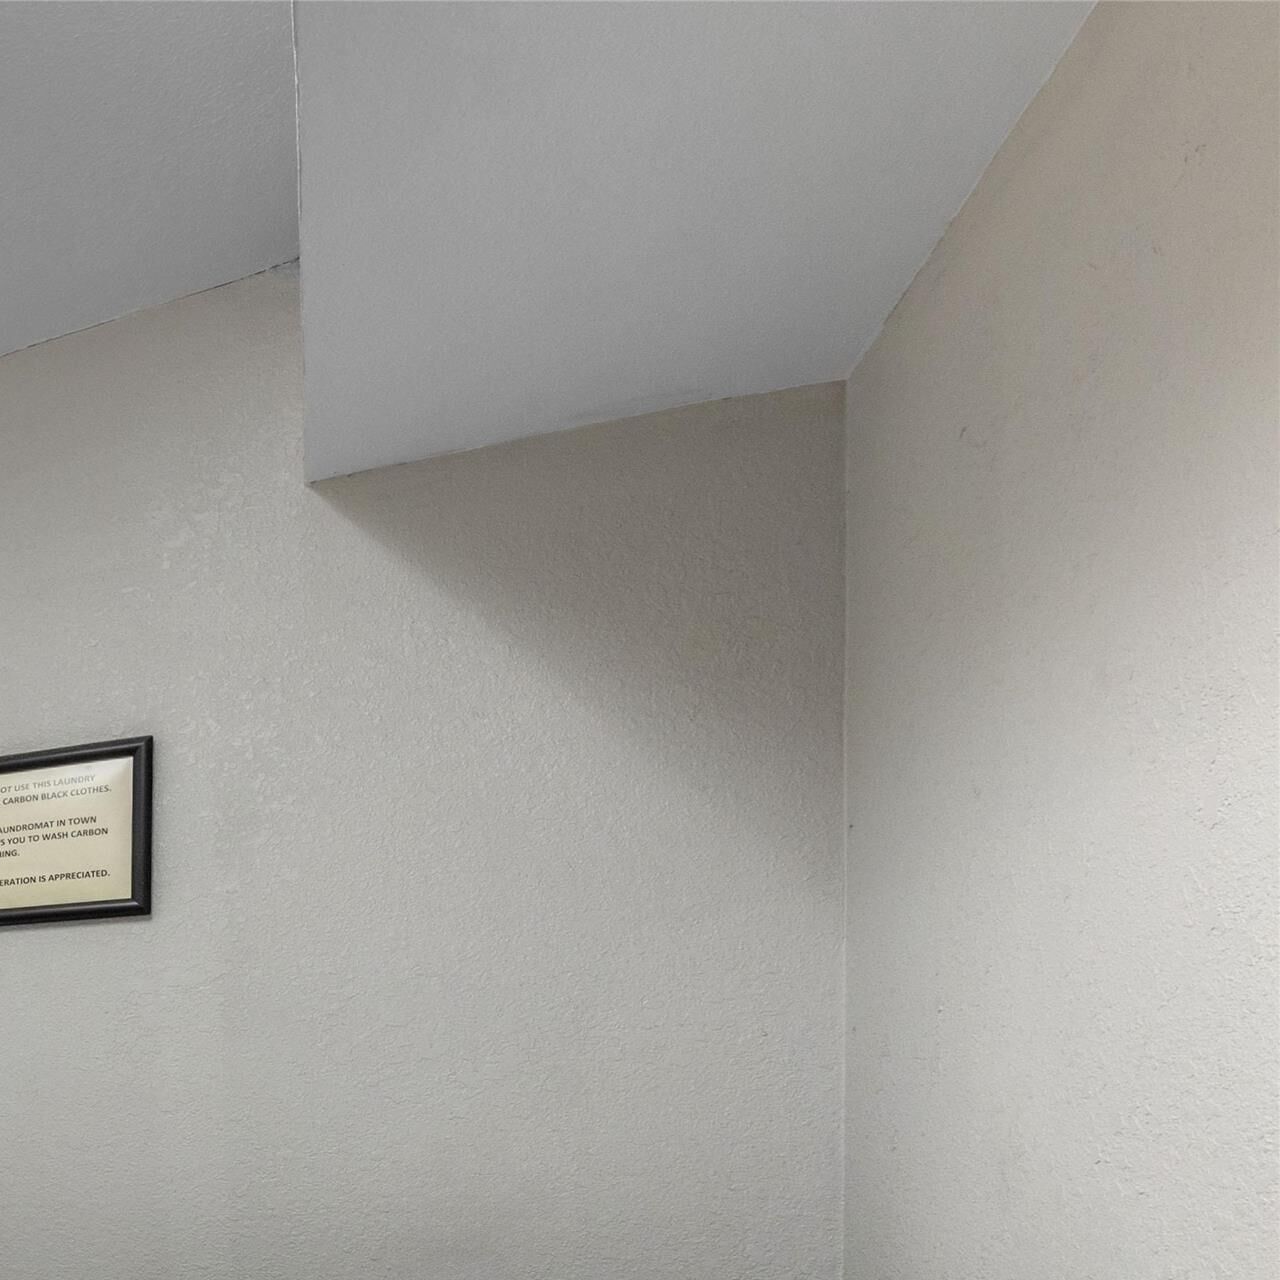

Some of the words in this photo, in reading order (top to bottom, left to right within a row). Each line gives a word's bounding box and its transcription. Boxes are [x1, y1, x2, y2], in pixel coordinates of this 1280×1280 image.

[14, 783, 30, 792] USE
[32, 780, 51, 789] THIS
[53, 774, 95, 786] LAUNDRY
[2, 794, 38, 805] CARBON
[41, 790, 69, 801] BLACK
[70, 784, 112, 796] CLOTHES.
[56, 819, 65, 827] IN
[68, 816, 97, 826] TOWN
[7, 836, 25, 845] YOU
[28, 834, 40, 843] TO
[42, 831, 68, 841] WASH
[71, 827, 108, 838] CARBON
[38, 875, 46, 883] IS
[48, 869, 110, 882] APPRECIATED.
